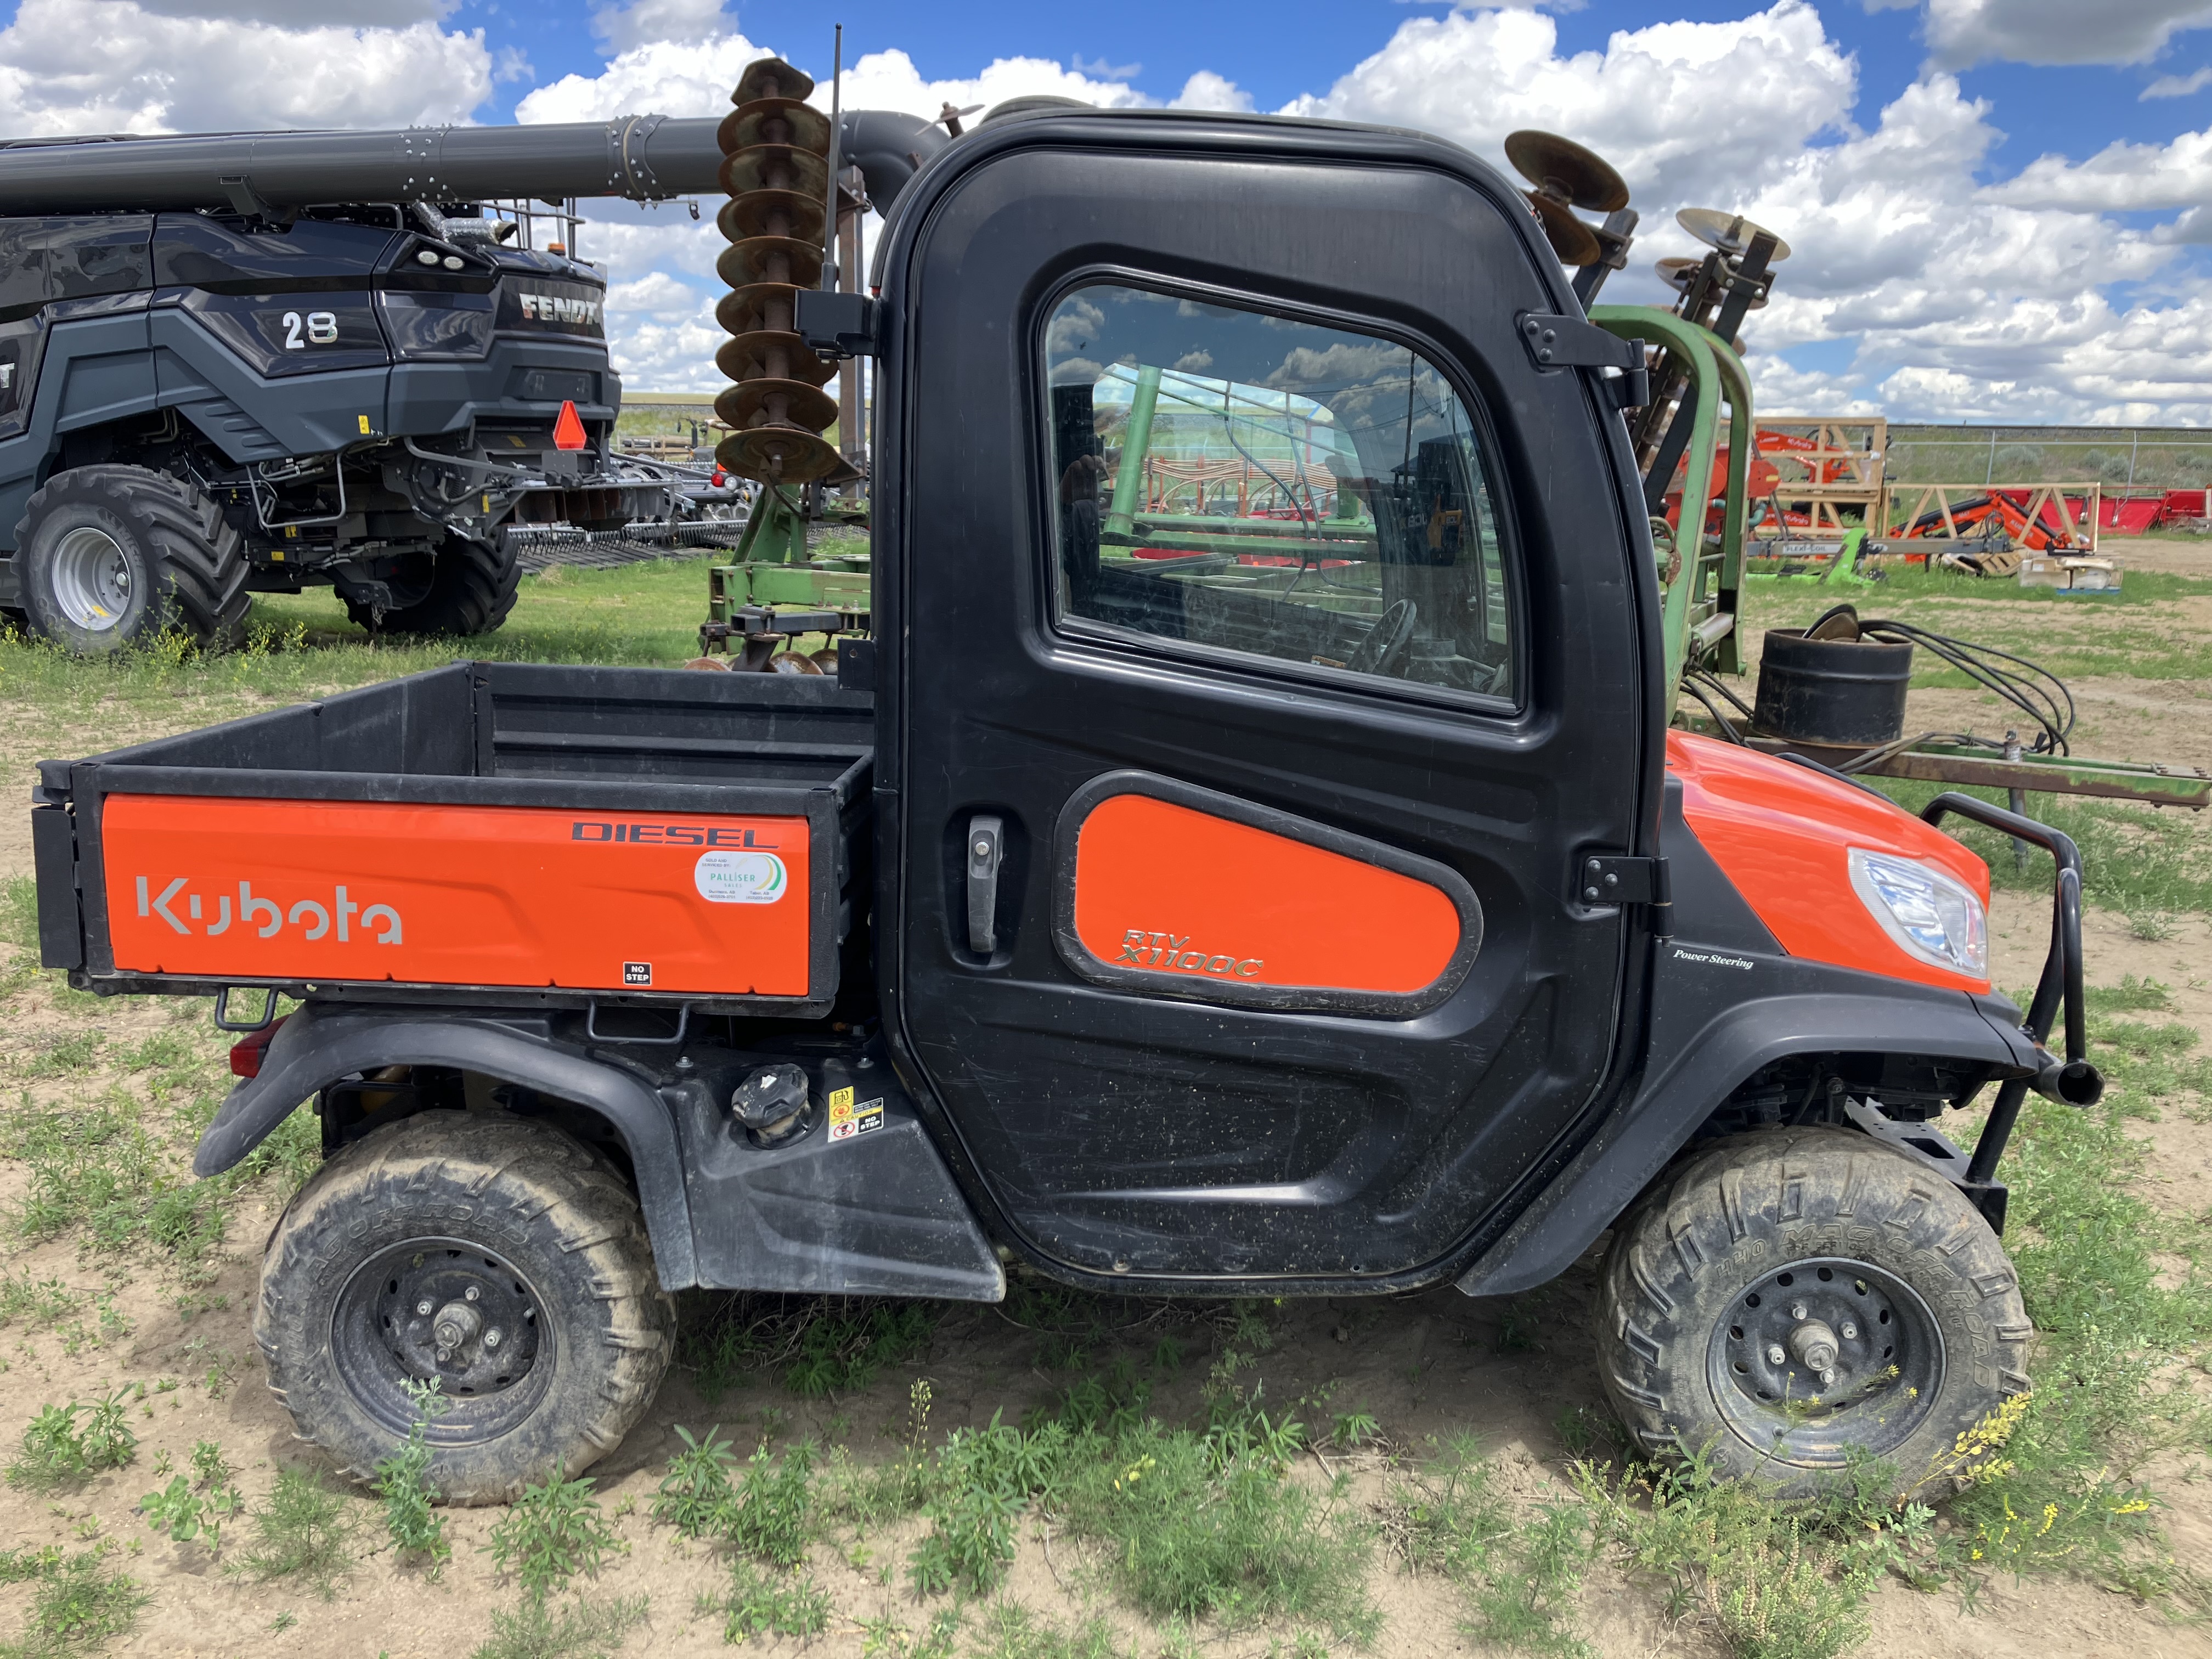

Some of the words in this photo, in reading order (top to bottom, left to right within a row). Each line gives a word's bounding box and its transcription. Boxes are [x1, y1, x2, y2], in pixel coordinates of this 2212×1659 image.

[519, 293, 597, 325] FENDT
[283, 311, 338, 349] 28
[1784, 514, 1809, 525] Kubota
[571, 822, 779, 849] DIESEL
[710, 872, 755, 882] PALLISER
[136, 875, 402, 945] Kubota
[1122, 929, 1190, 949] RTV
[1114, 944, 1263, 977] X1100C
[1673, 949, 1709, 961] Power
[1708, 954, 1754, 970] Steering
[847, 1110, 873, 1120] CAUTION
[860, 1120, 881, 1130] STEP
[348, 1204, 414, 1239] OFF
[422, 1204, 528, 1245] ROAD
[1716, 1238, 1768, 1279] 440
[1782, 1223, 1877, 1245] MAG
[1886, 1237, 1956, 1279] OFF
[1949, 1291, 1991, 1387] ROAD
